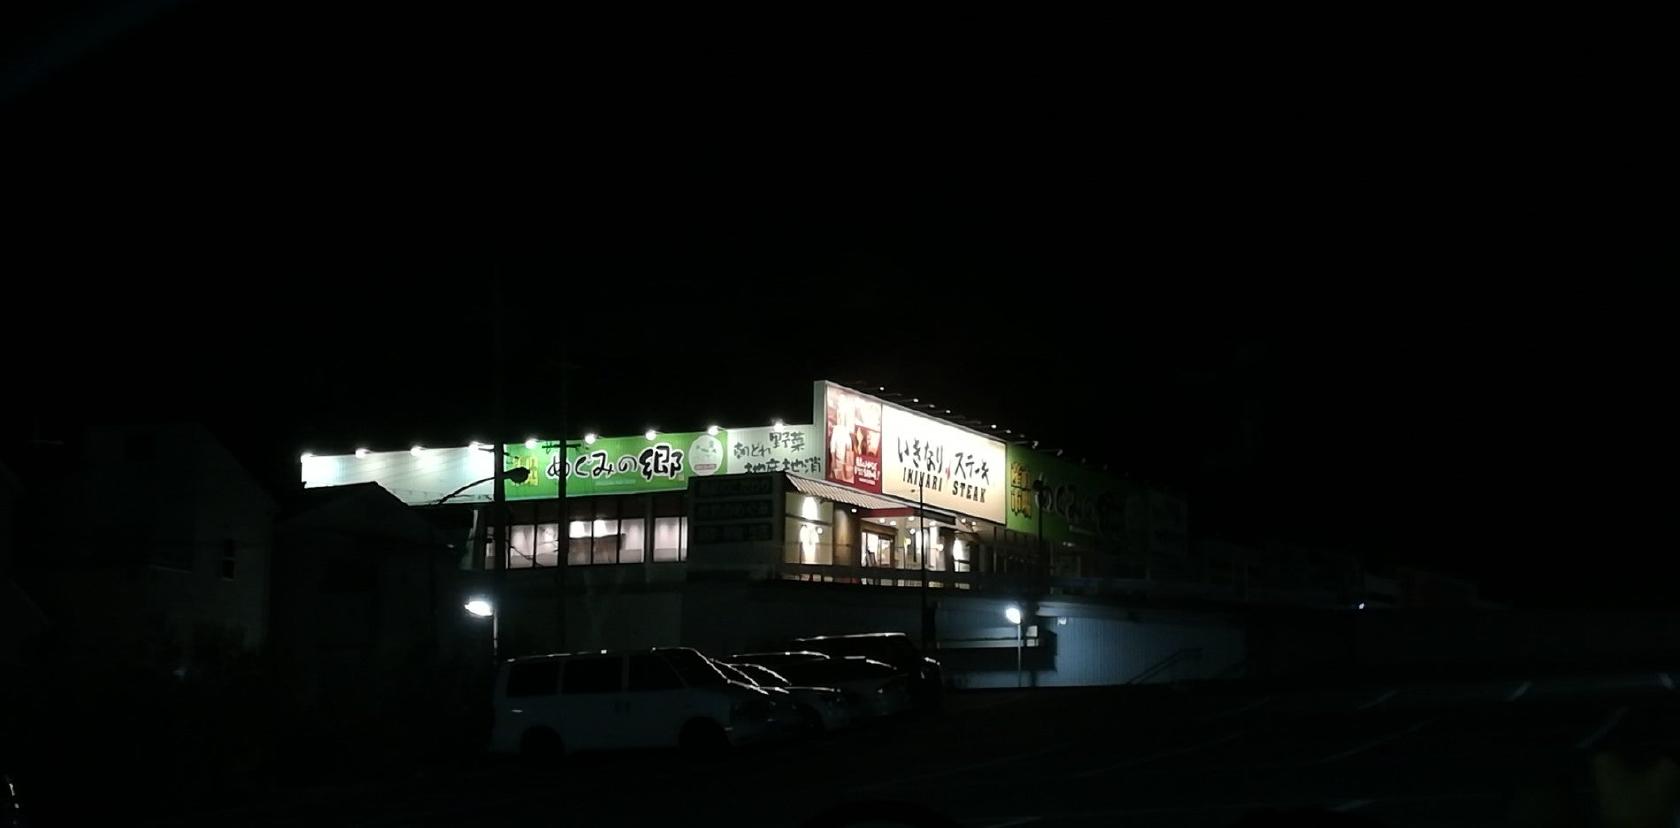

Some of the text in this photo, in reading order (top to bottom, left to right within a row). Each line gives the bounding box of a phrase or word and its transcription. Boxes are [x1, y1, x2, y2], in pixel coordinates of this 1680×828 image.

[769, 431, 805, 453] 野菜
[897, 437, 944, 474] いきなり
[547, 444, 684, 481] めぐみの郷
[744, 456, 821, 473] 地産地消
[902, 467, 943, 492] IKINARI
[952, 480, 987, 503] STEAK
